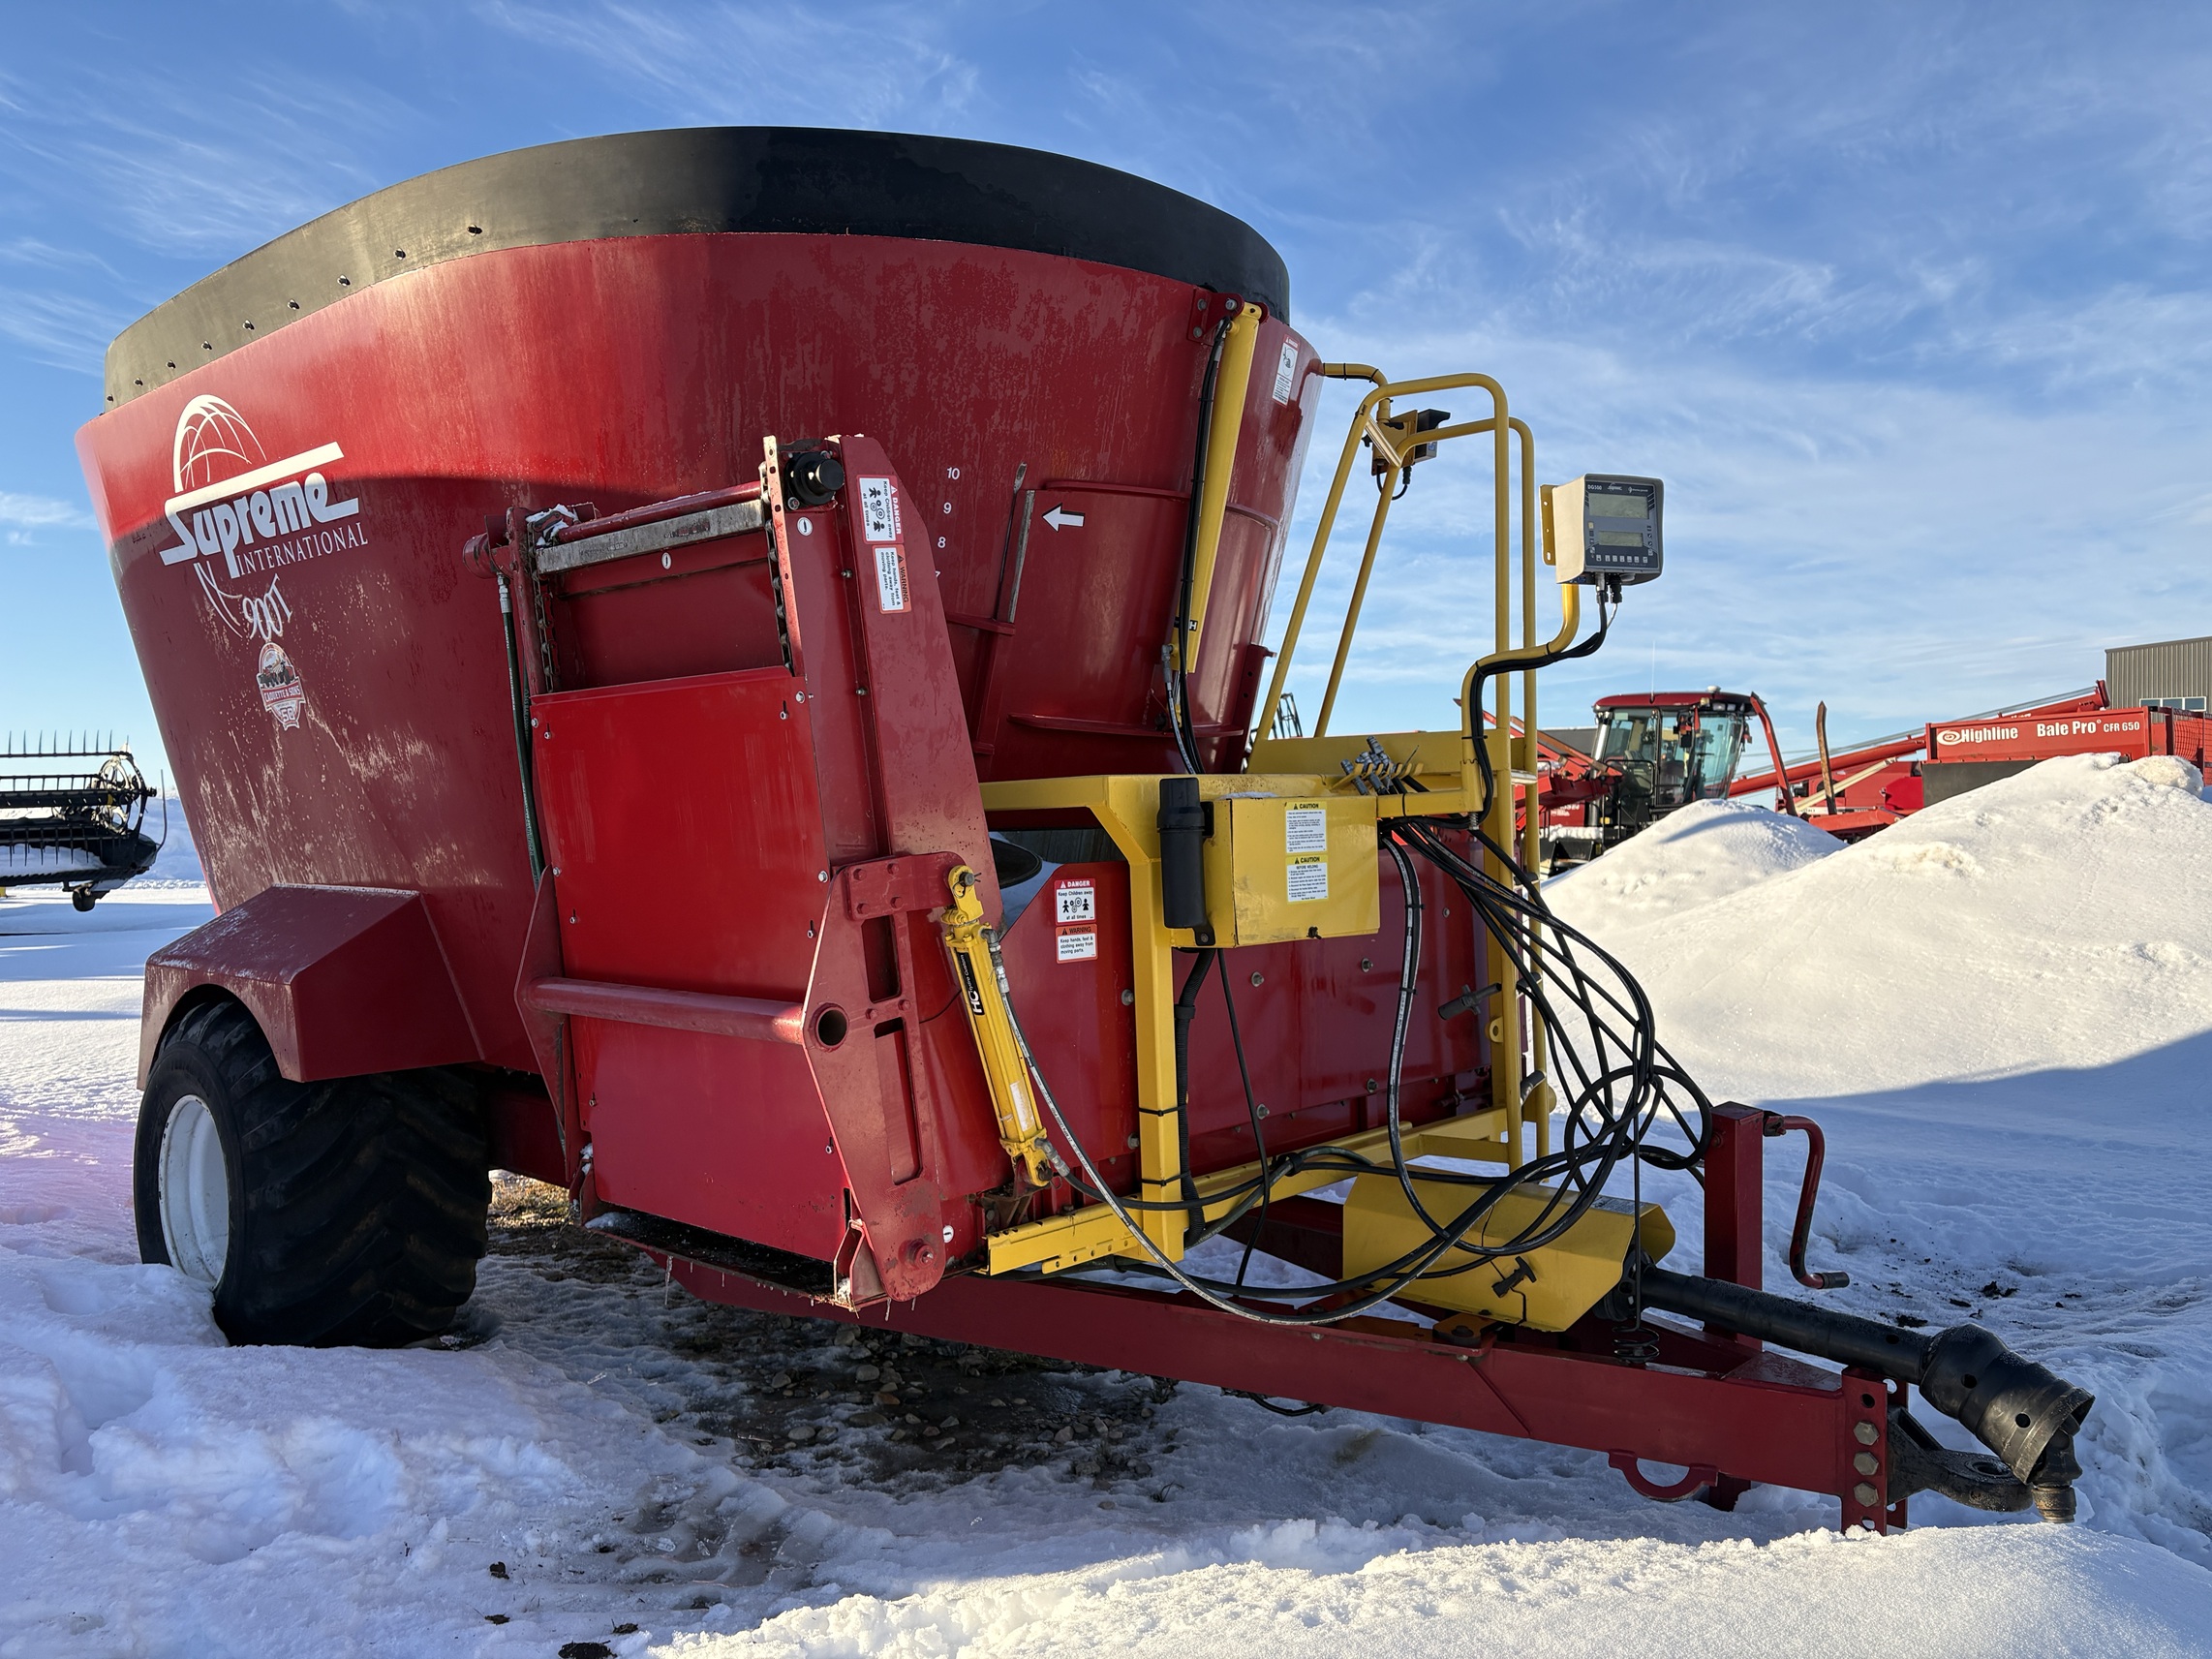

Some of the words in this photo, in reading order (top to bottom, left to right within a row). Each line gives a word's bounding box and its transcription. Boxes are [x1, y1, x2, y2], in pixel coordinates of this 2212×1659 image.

[947, 467, 960, 480] 10
[892, 497, 901, 535] DANGER
[943, 502, 952, 514] 9
[159, 472, 360, 578] Supreme
[236, 521, 368, 577] INTERNATIONAL
[937, 536, 946, 548] 8
[900, 567, 909, 603] WARNING
[1961, 726, 2018, 744] Highline
[2037, 722, 2069, 737] Bale
[2103, 722, 2120, 733] CFR
[2122, 721, 2140, 732] 650
[968, 990, 983, 1013] HC
